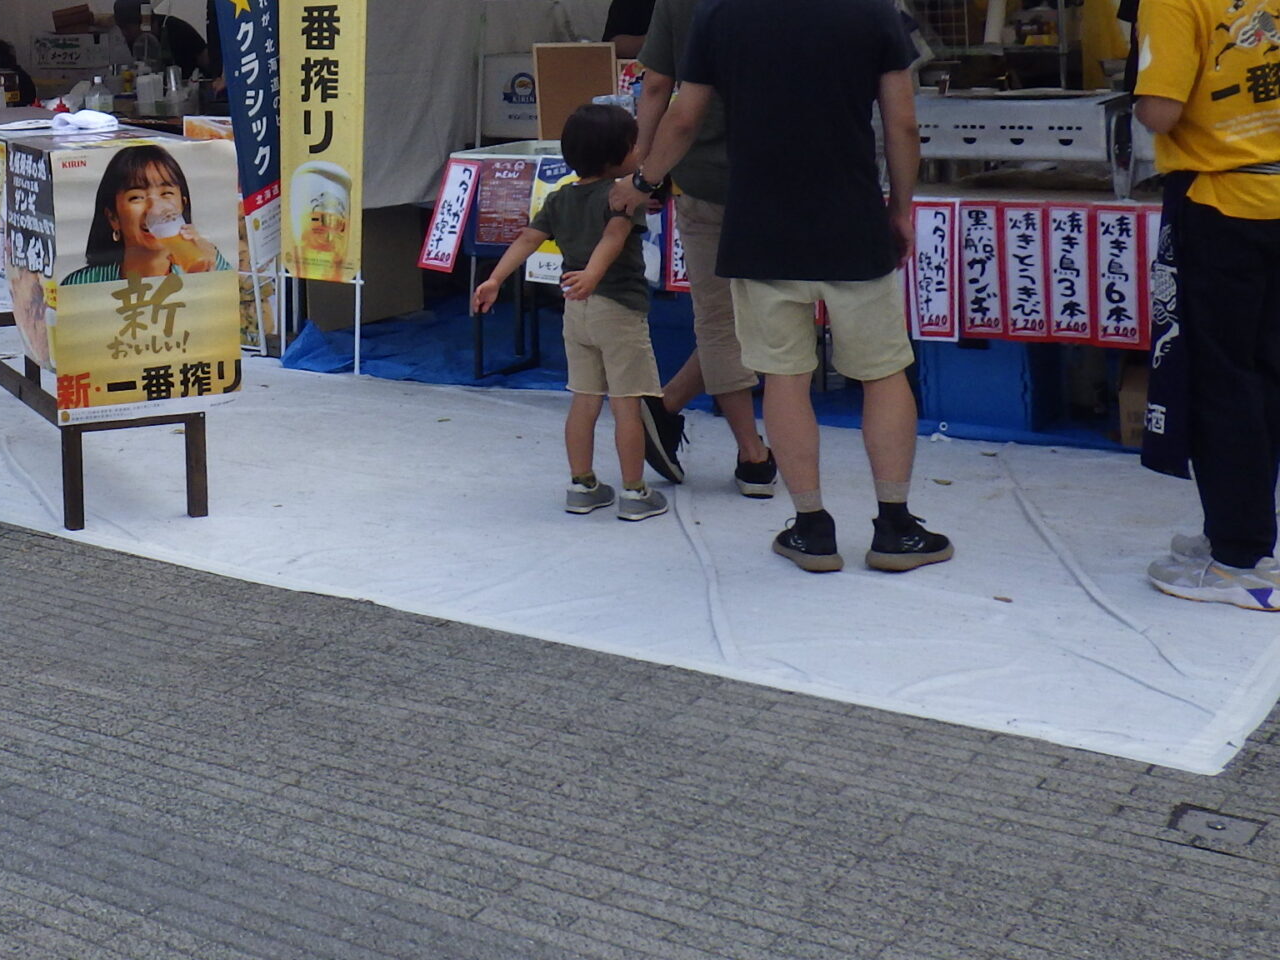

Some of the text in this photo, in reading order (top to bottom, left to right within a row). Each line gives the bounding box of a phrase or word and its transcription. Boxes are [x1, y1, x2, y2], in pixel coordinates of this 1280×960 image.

[236, 21, 271, 176] クラシック
[61, 159, 87, 169] KIRIN
[932, 210, 948, 293] ワタリガニ
[965, 209, 997, 317] 黒船ザンギ
[1009, 211, 1040, 317] 焼きとうきび
[1053, 211, 1086, 319] 焼き鳥3本
[1101, 215, 1133, 324] 焼き鳥6本
[107, 330, 190, 359] おいしい!
[111, 272, 186, 339] 新
